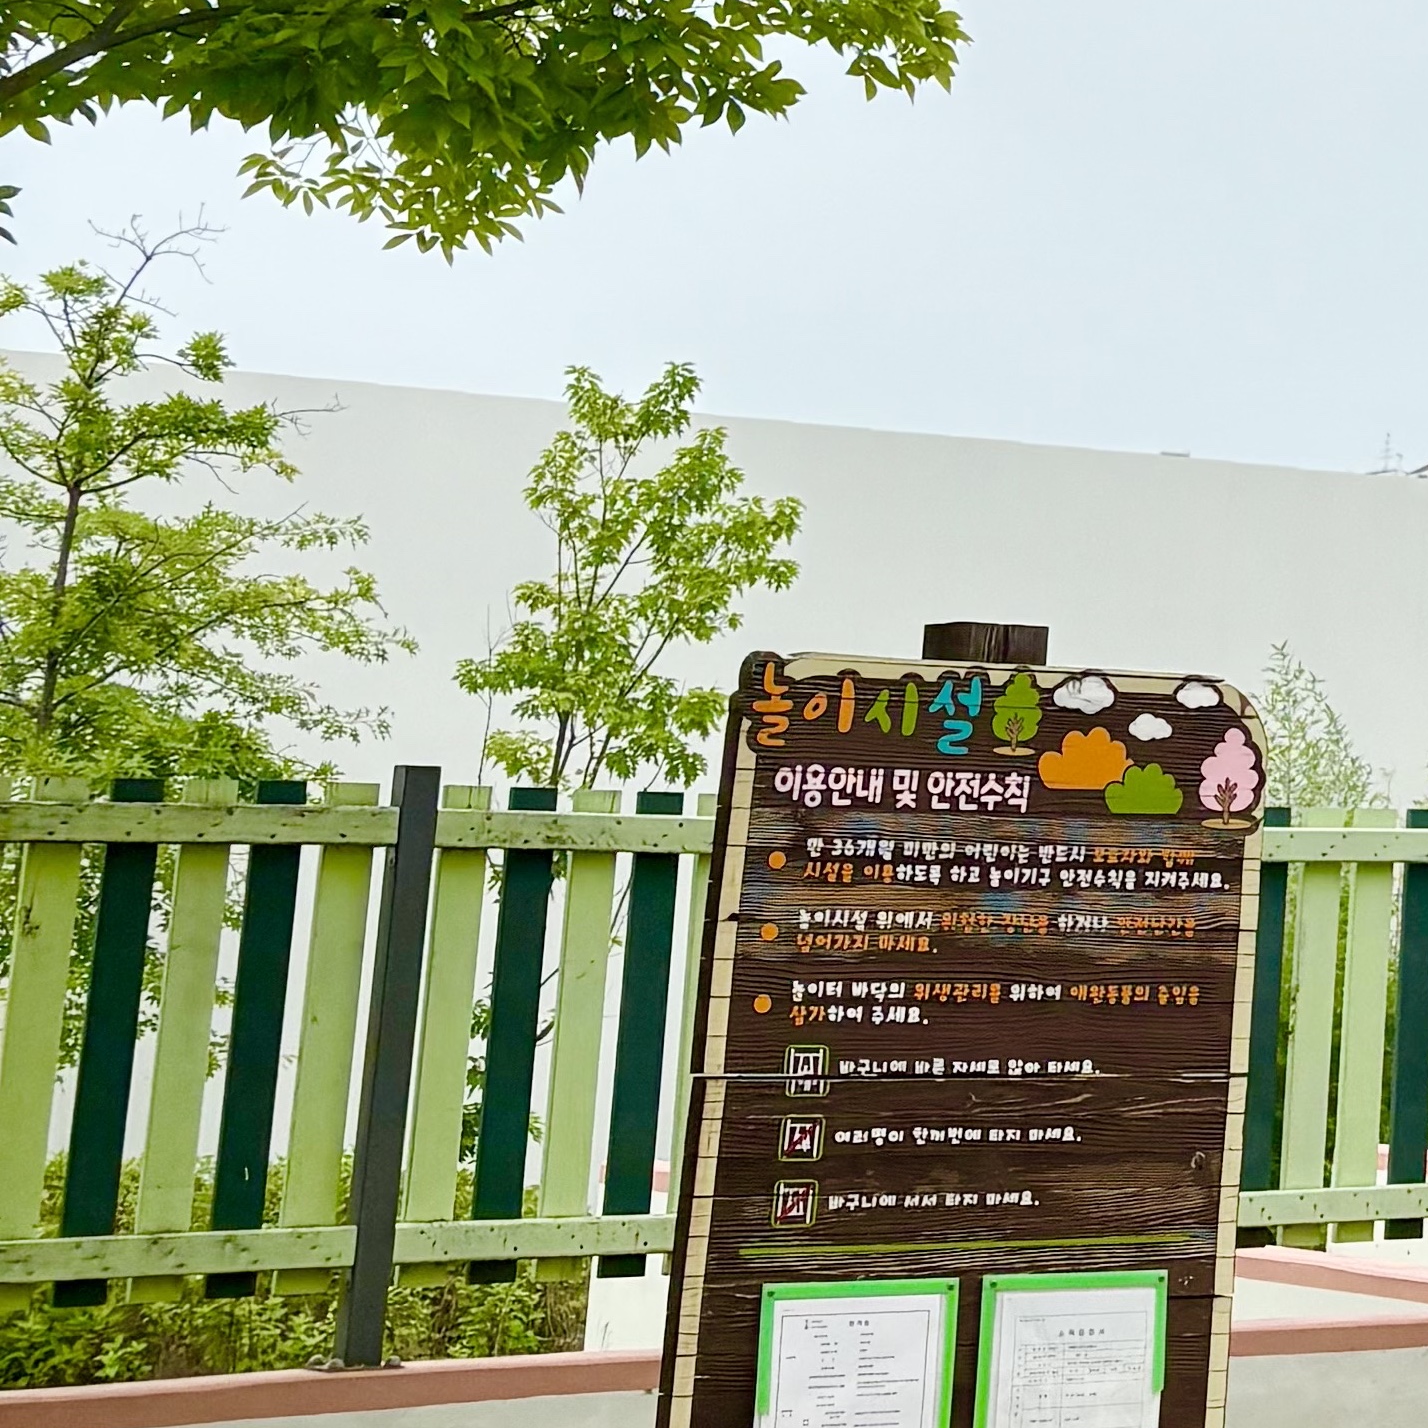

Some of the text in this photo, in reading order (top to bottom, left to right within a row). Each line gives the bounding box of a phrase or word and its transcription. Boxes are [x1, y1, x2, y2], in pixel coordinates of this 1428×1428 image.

[752, 662, 983, 756] 놀이시설
[774, 764, 1032, 814] 이용안내 및 안전수칙
[807, 837, 824, 858] 만
[833, 838, 895, 861] 36개월
[904, 840, 957, 861] 미만의
[965, 842, 1030, 864] 어린이는
[1039, 844, 1086, 864] 반드시
[803, 861, 1230, 891] 시설을 이용하도록 하고 놀이기구 안전수칙을 지켜주세요.
[799, 909, 869, 932] 놀이시설
[875, 911, 934, 930] 위에서
[796, 933, 938, 954] 넘어가지 마세요.
[791, 980, 1200, 1006] 놀이터 바닥의 위생관리를 위하여 애완동물의 출입을
[789, 1005, 929, 1026] 삼가하여 주세요.
[839, 1057, 1100, 1076] 바구니에 바른 자세로 앉아 타세요.
[834, 1127, 905, 1147] 여러명이
[988, 1128, 1021, 1142] 타지
[1028, 1126, 1082, 1142] 마세요.
[828, 1190, 1040, 1211] 바구니에 서서 타지 마세요.
